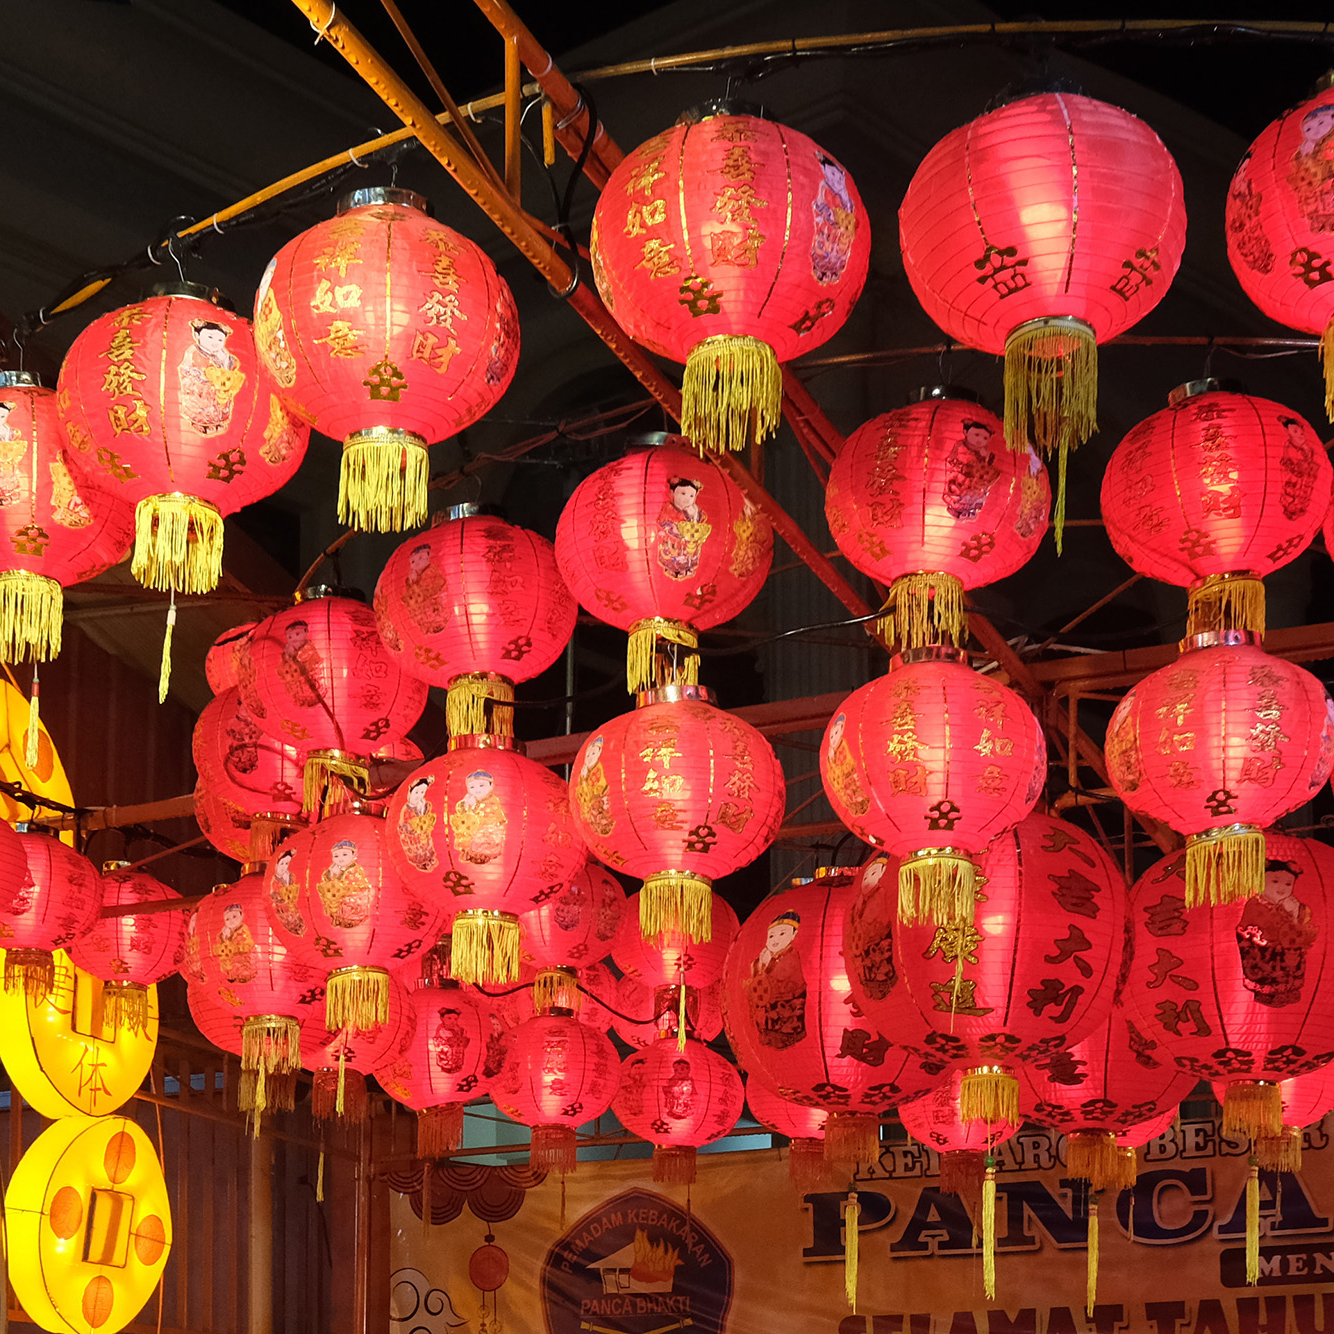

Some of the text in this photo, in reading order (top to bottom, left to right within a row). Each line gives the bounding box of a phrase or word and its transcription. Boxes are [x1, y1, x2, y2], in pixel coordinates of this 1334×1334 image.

[71, 1044, 113, 1108] 体
[1144, 1112, 1330, 1163] BESR
[560, 1208, 715, 1275] PEMADAM KEBAKARAN
[801, 1166, 1334, 1263] PANCA
[580, 1295, 692, 1316] PANCA BHAKTI
